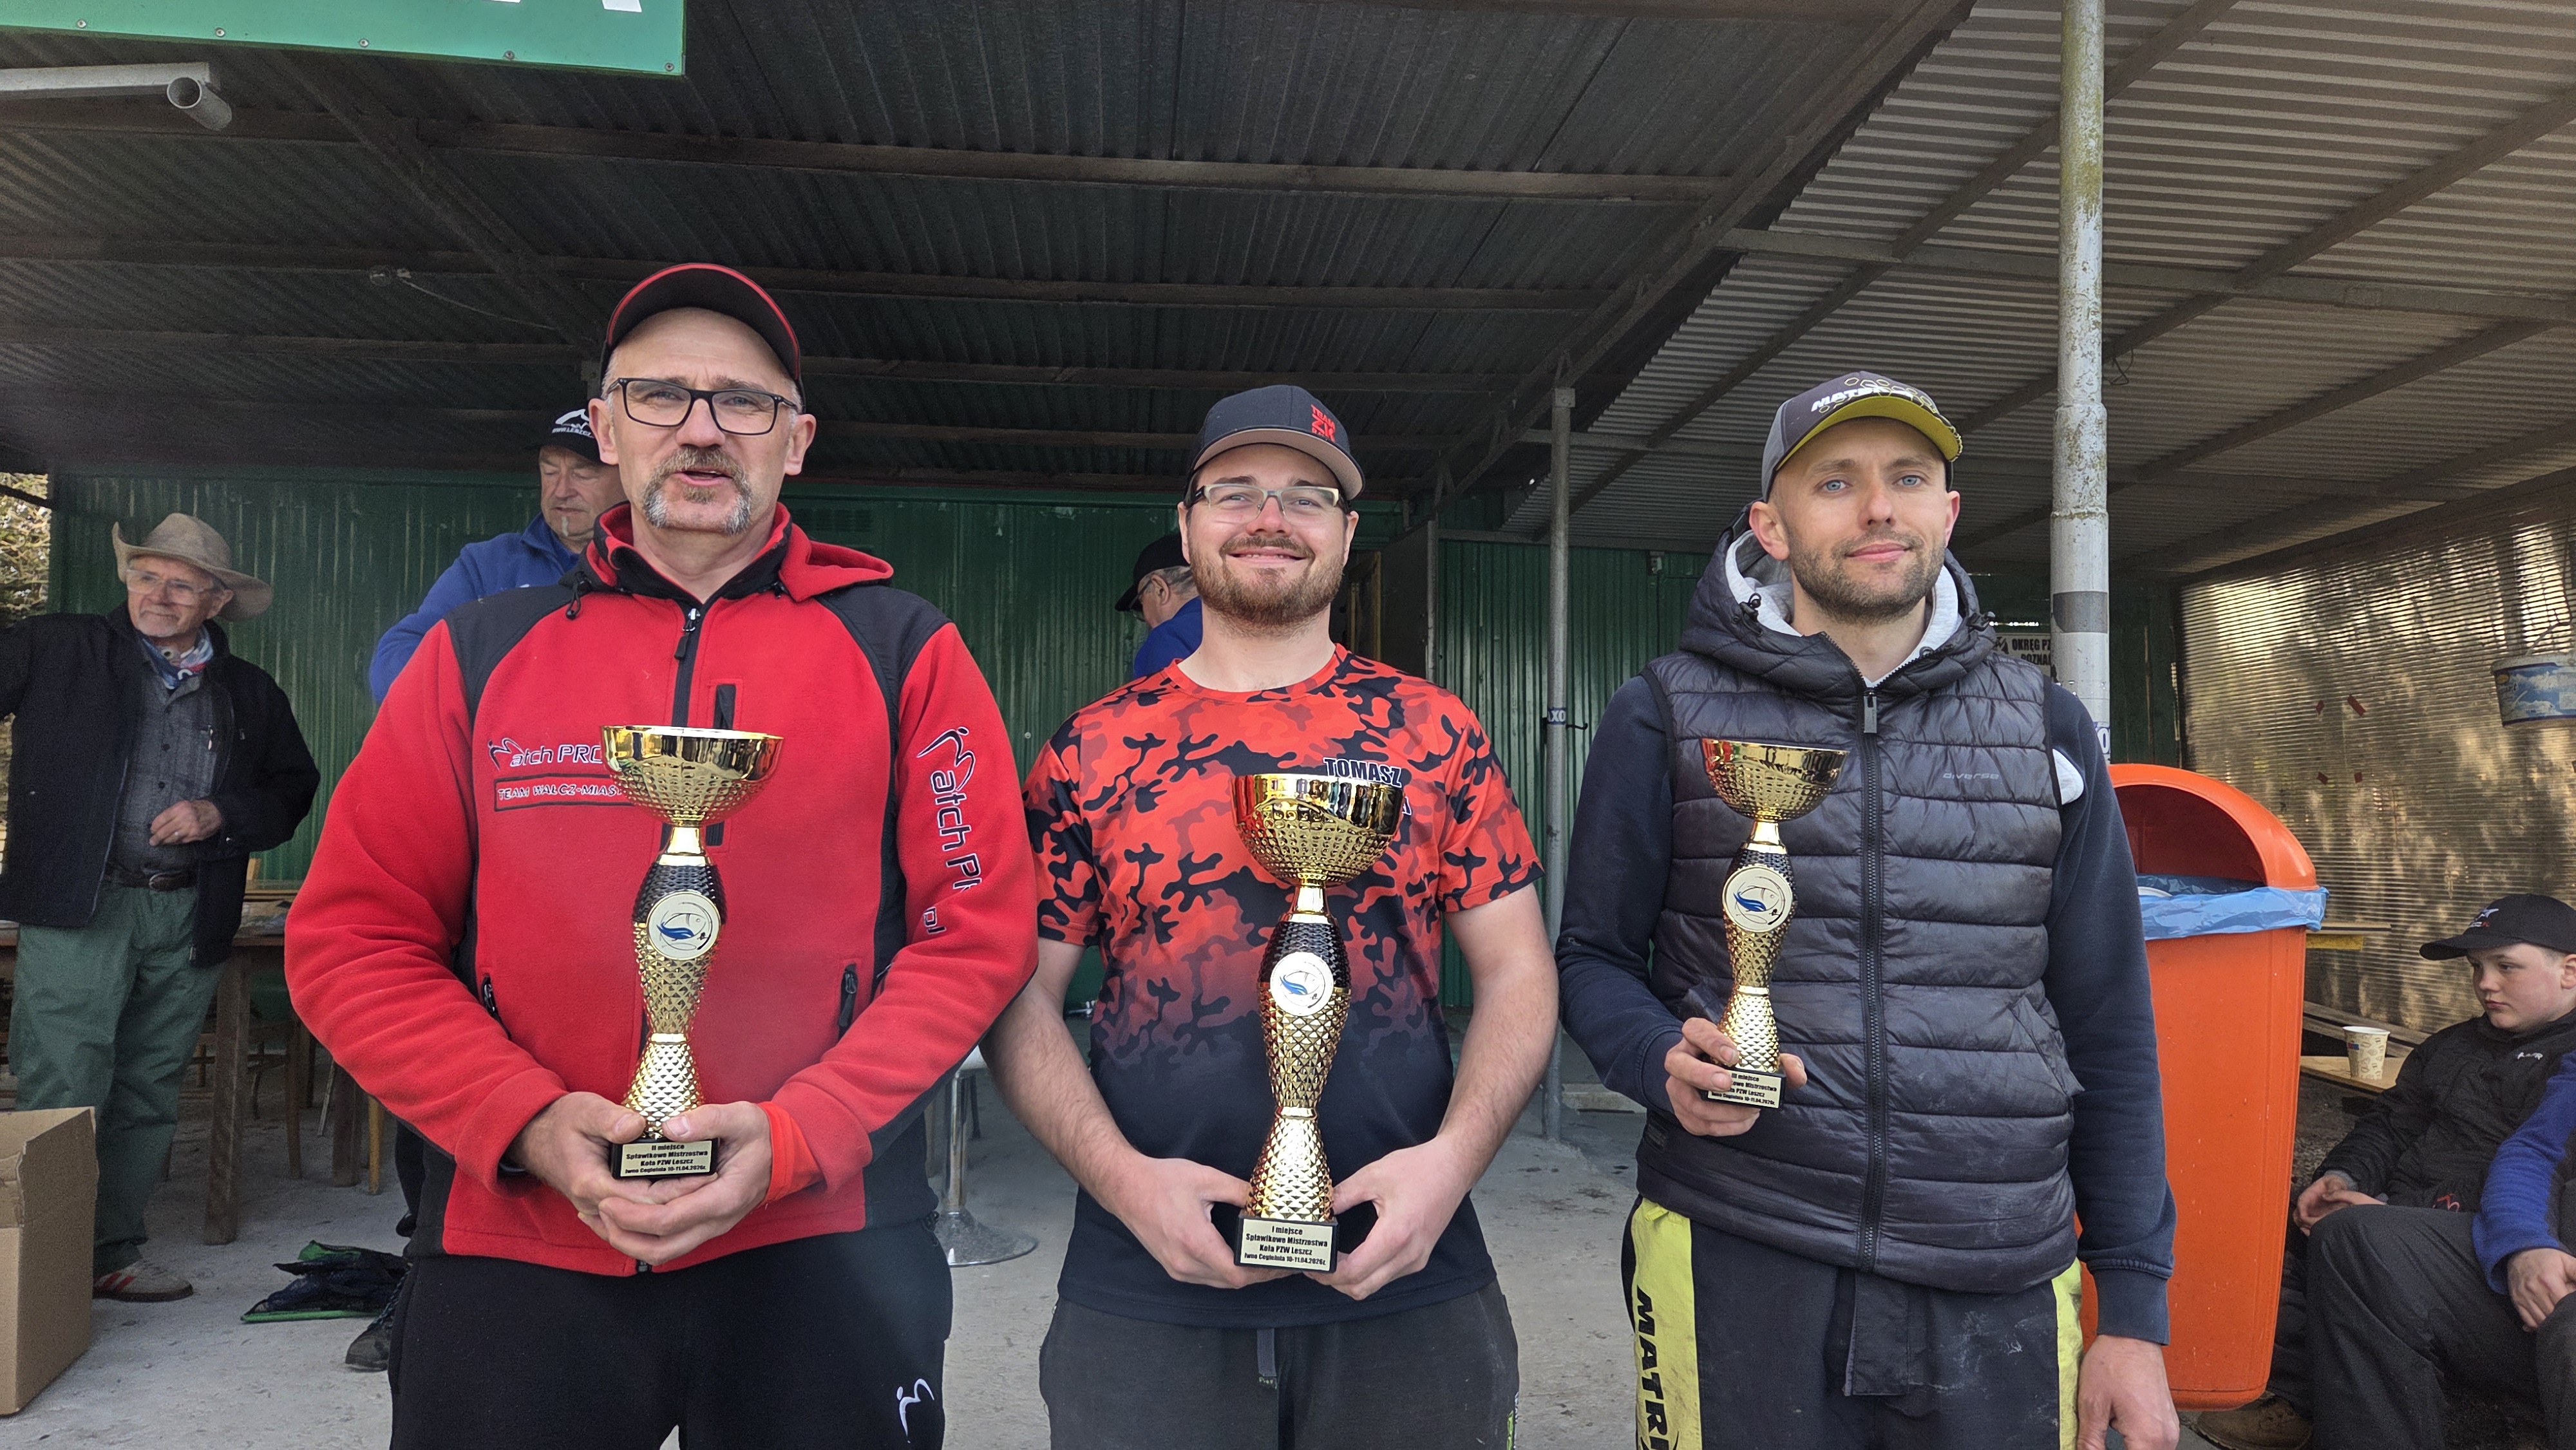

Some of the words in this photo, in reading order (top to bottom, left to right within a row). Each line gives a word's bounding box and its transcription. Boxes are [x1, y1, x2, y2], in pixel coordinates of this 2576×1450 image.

[2012, 638, 2040, 653] OKRĘG
[2042, 639, 2051, 650] PZ
[1323, 757, 1402, 788] TOMASZ
[498, 787, 530, 800] TEAM
[533, 784, 622, 796] WAŁCZ-MIAS
[1276, 1227, 1303, 1235] miejsce
[1287, 1237, 1328, 1247] Mistrzostwa
[1276, 1245, 1290, 1254] PZW
[1291, 1247, 1312, 1256] Leszcz
[1637, 1285, 1674, 1450] MATRI
